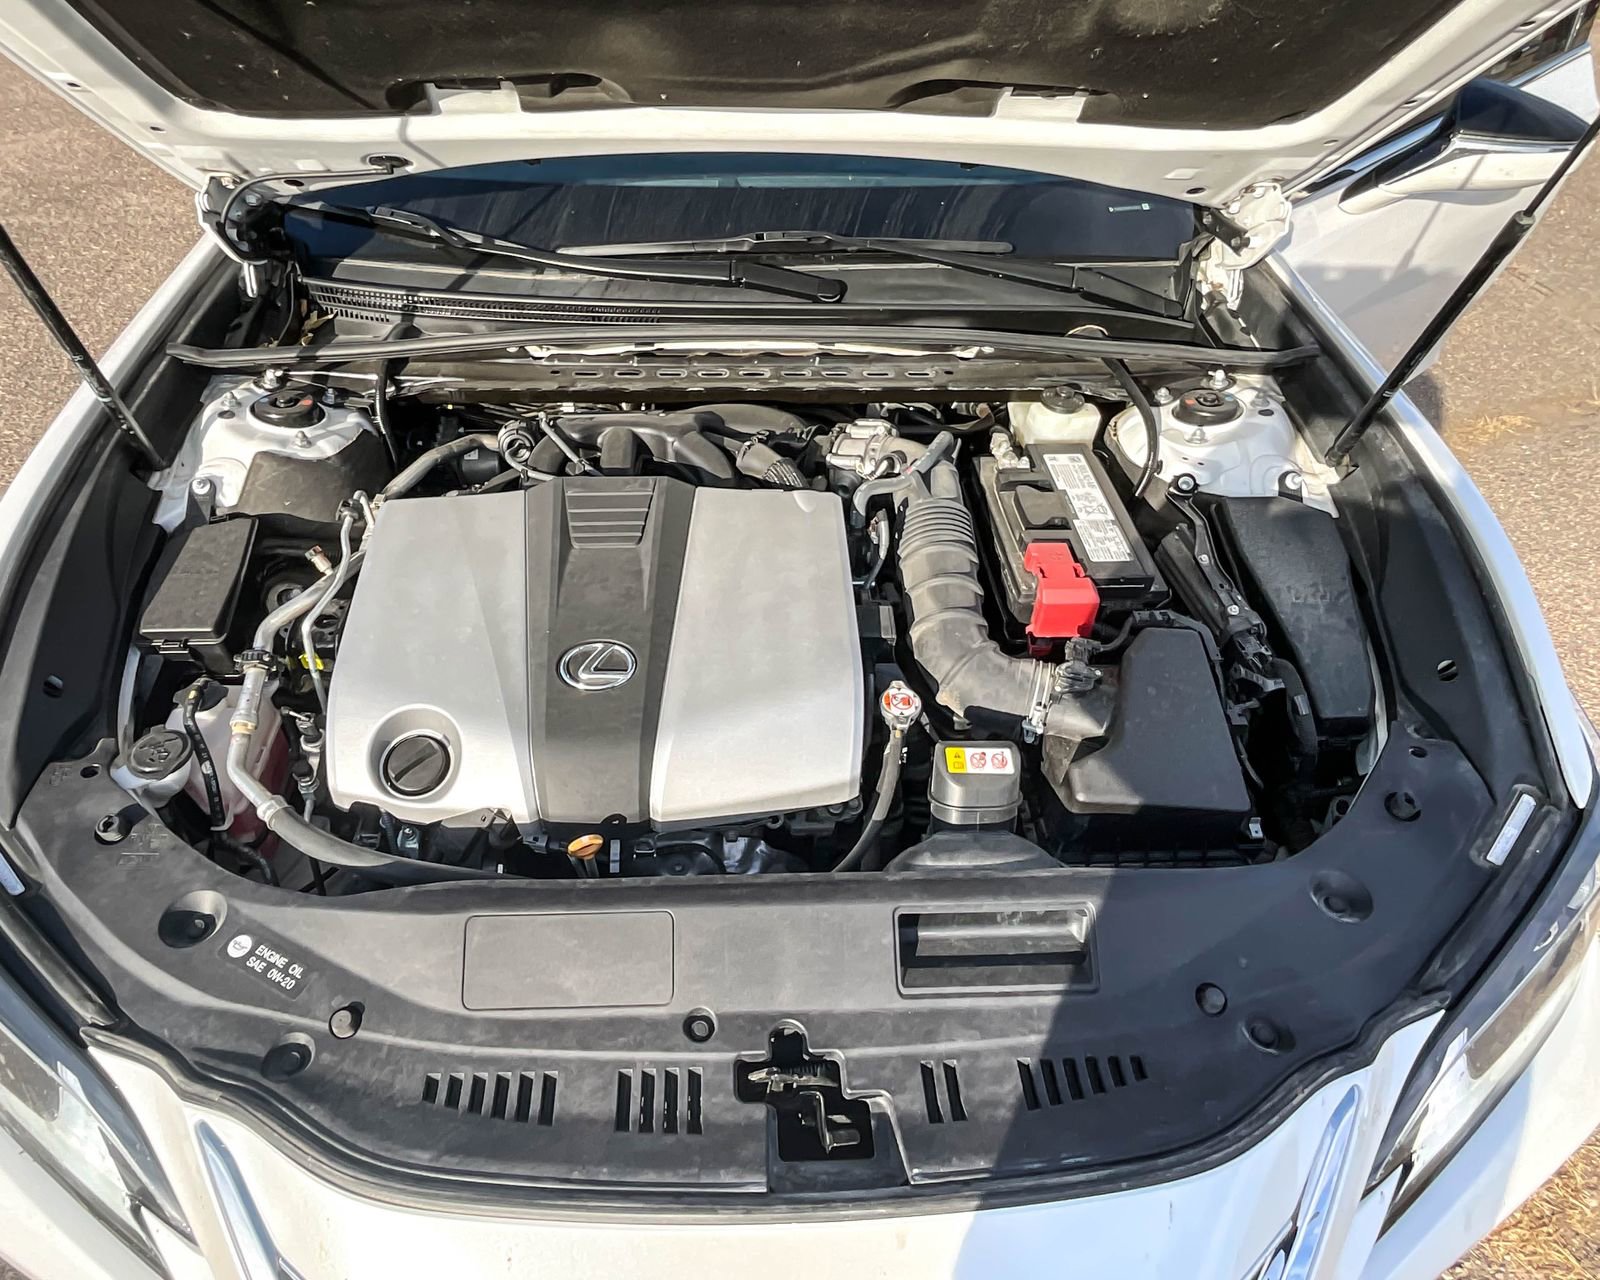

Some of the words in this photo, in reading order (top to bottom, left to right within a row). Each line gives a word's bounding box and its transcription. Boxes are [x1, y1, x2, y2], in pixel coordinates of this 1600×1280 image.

[246, 956, 267, 973] SAE
[267, 968, 296, 990] 0W-20
[255, 945, 288, 968] ENGINE
[288, 964, 304, 979] OIL
